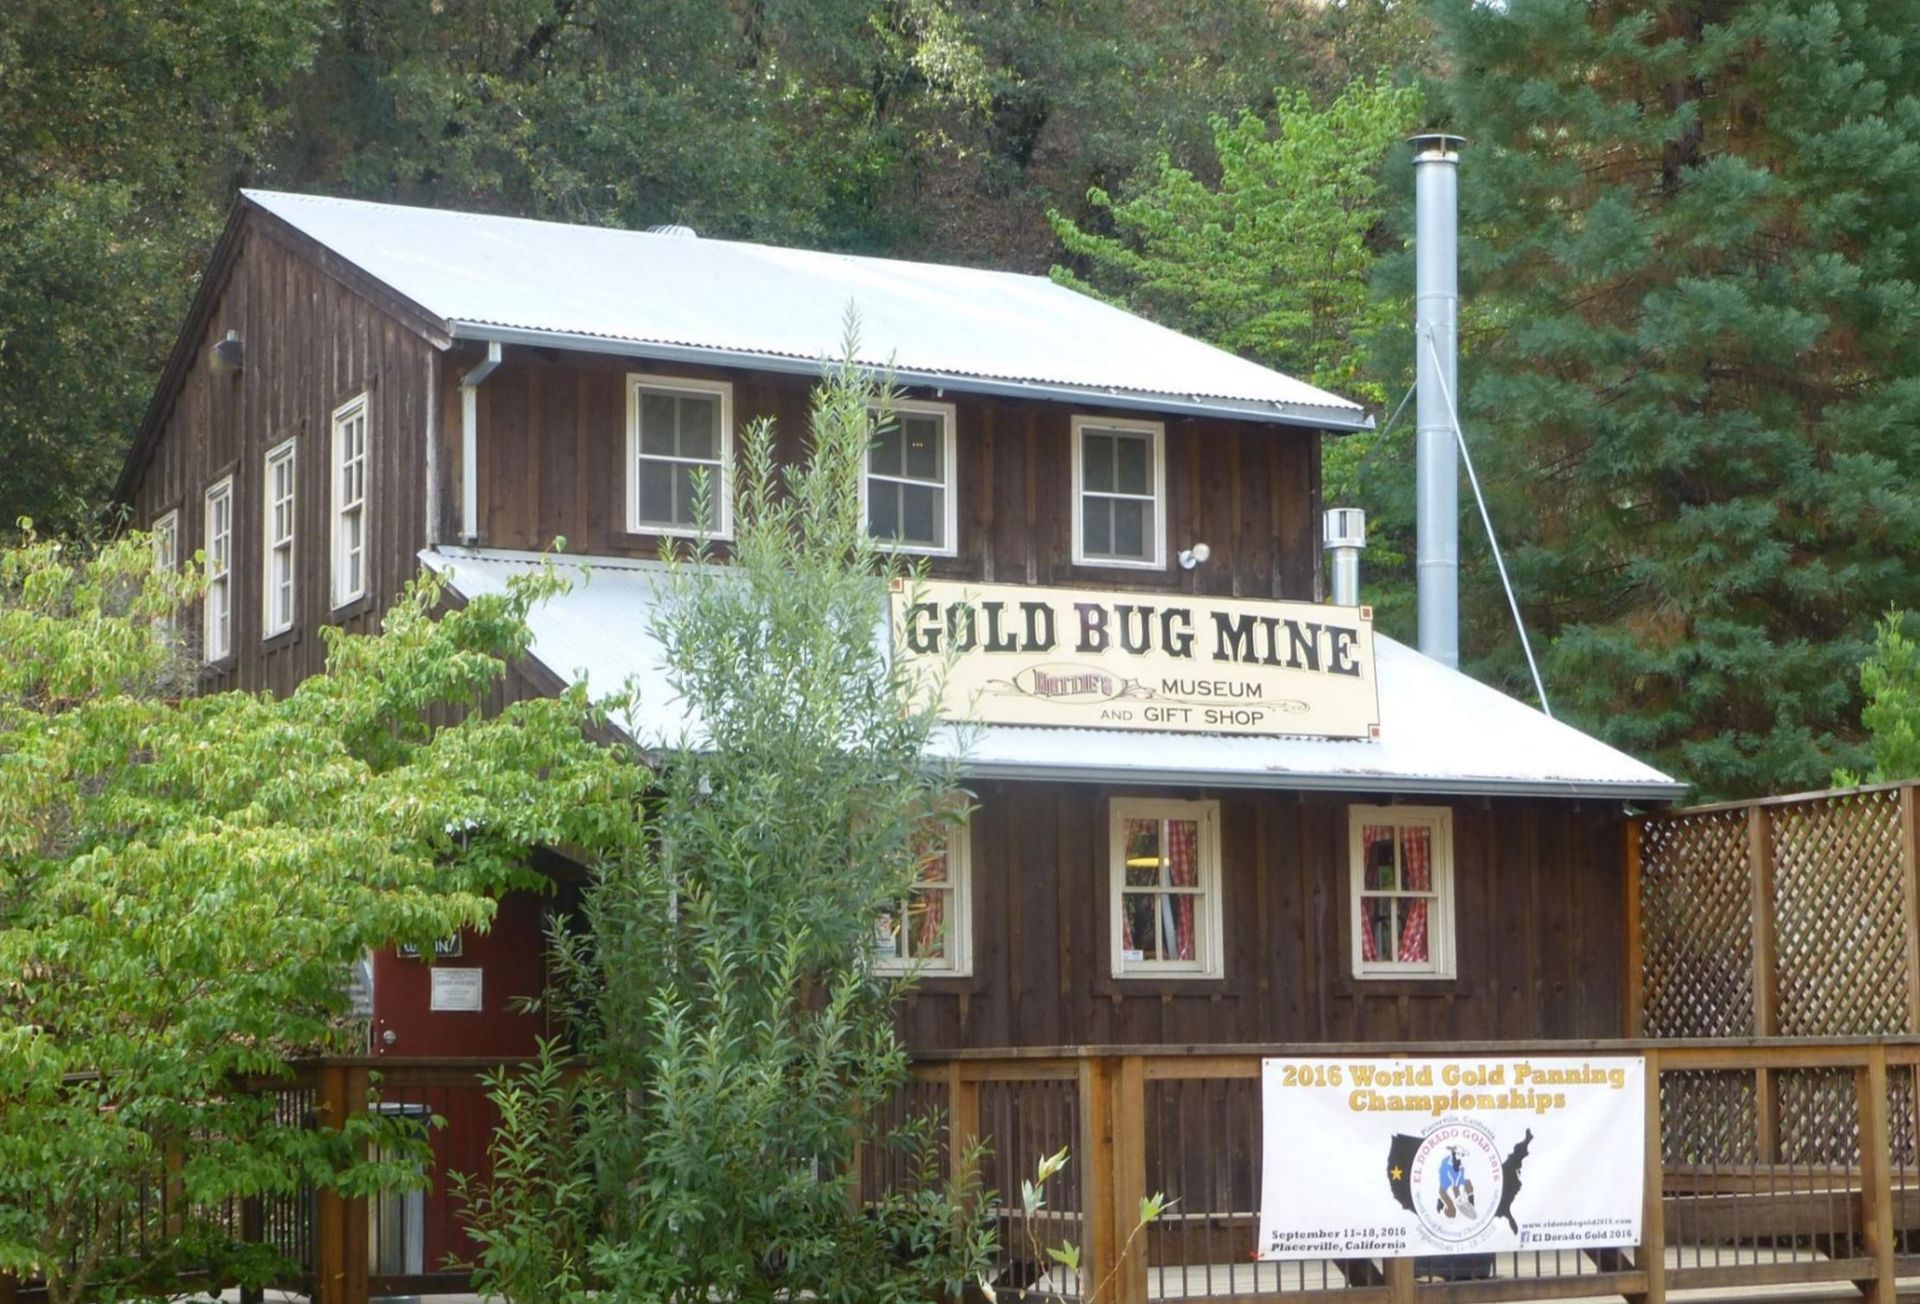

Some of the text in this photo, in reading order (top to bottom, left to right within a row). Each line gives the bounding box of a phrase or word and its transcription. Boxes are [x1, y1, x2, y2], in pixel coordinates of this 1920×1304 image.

[905, 601, 1364, 678] GOLD BUG MINE
[1162, 679, 1263, 698] MUSEUM
[1100, 707, 1264, 725] AND GIFT SHOP
[1282, 1063, 1626, 1089] 2016 World Gold Panning
[1348, 1088, 1566, 1116] Championships
[1462, 1129, 1491, 1153] GOLD
[1271, 1229, 1340, 1241] September
[1544, 1231, 1582, 1242] Dorado
[1584, 1230, 1607, 1240] Gold
[1609, 1229, 1632, 1239] 2016
[1271, 1239, 1406, 1253] Placerville, California
